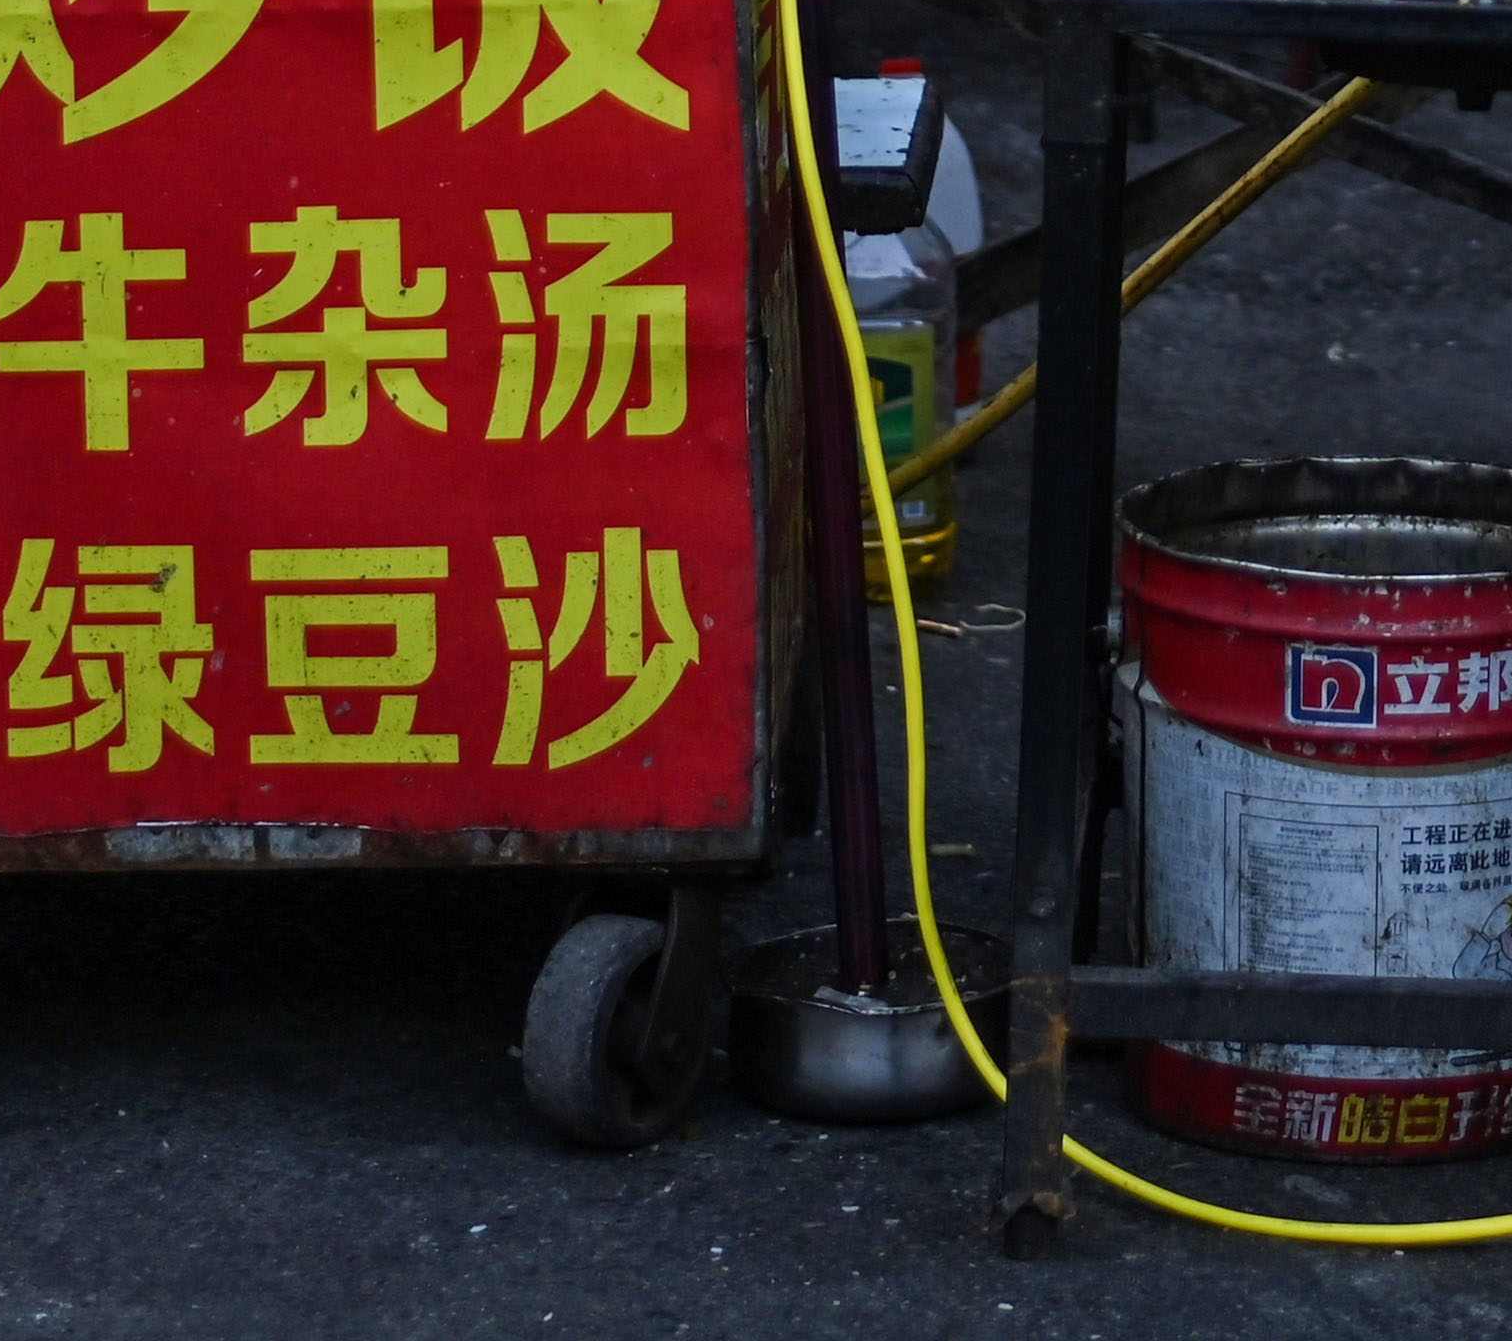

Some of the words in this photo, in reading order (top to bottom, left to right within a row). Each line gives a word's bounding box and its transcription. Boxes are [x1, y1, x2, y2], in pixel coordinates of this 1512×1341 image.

[3, 527, 700, 773] 绿豆沙
[1400, 846, 1512, 875] 请远离此地
